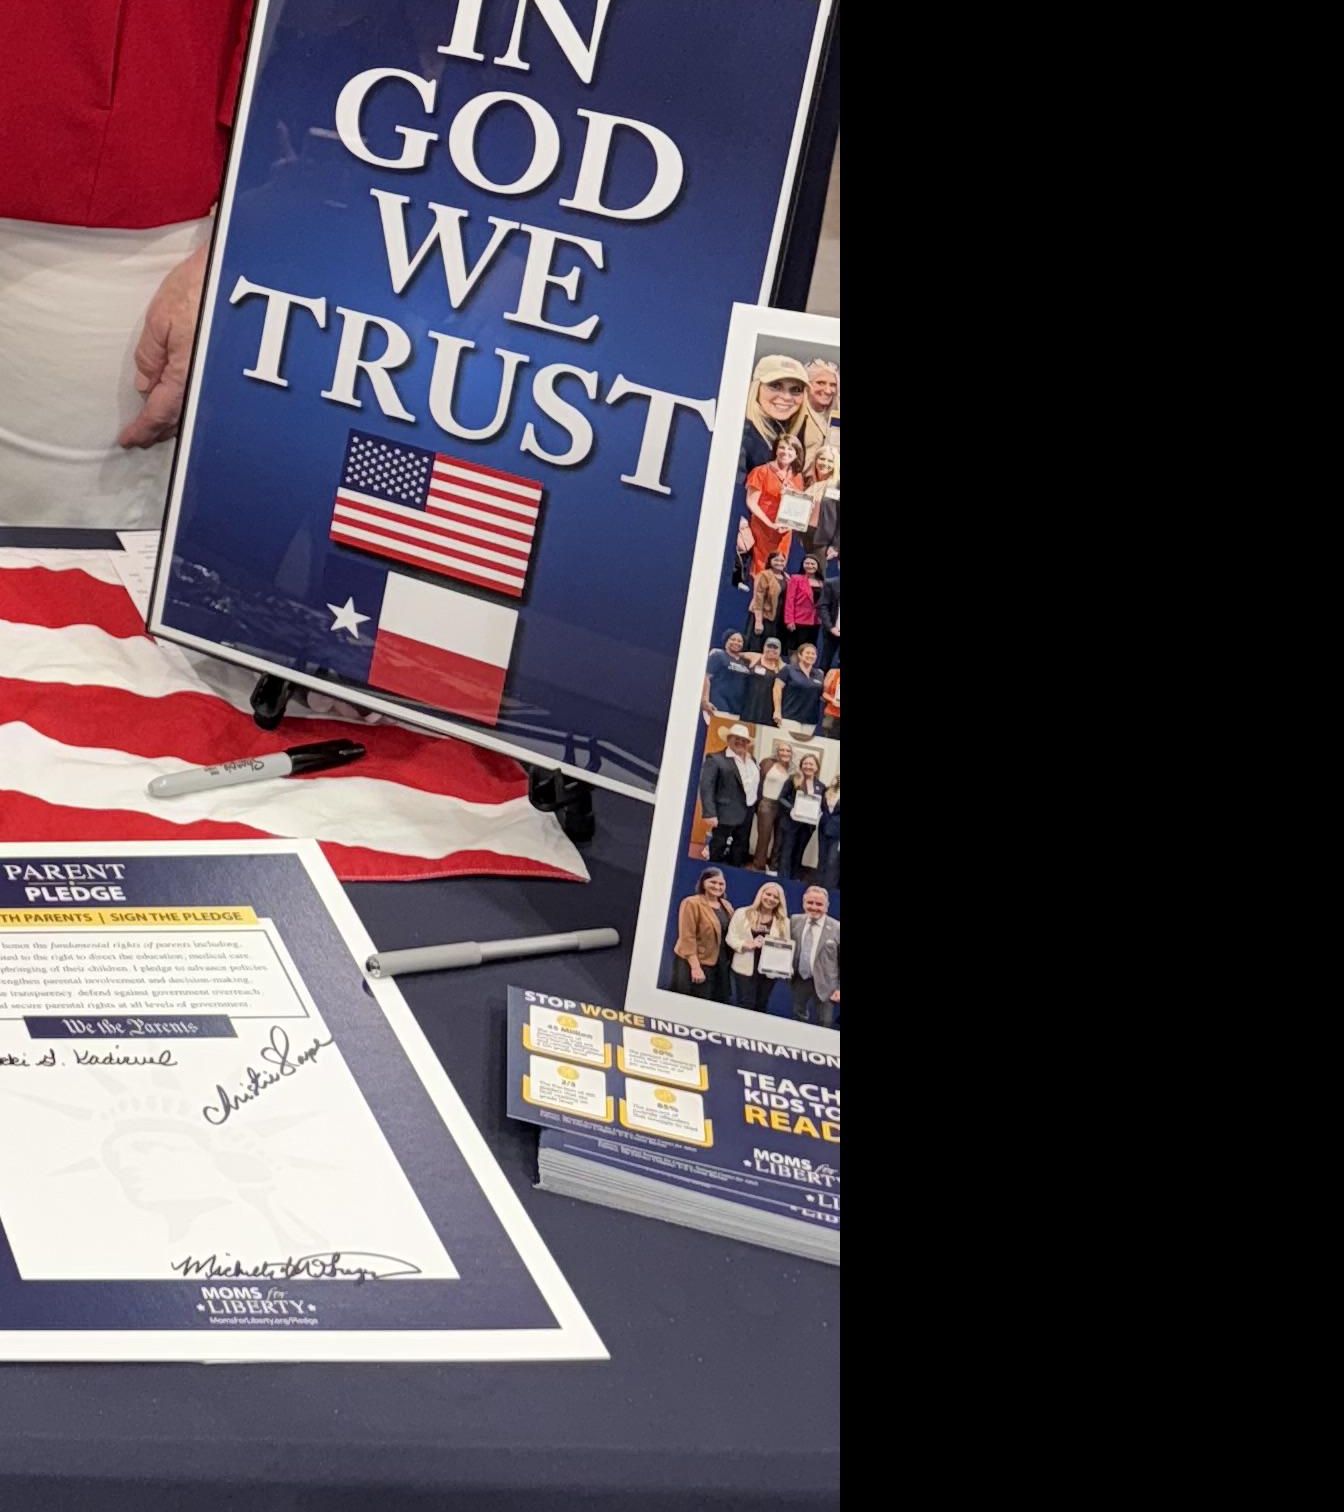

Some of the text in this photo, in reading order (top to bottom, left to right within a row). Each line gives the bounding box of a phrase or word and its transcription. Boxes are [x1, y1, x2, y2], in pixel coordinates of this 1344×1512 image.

[335, 67, 684, 220] GOD
[370, 188, 605, 340] WE
[229, 276, 716, 495] TRUST
[3, 863, 126, 881] PARENT
[25, 886, 126, 902] PLEDGE
[24, 912, 92, 924] PARENTS
[111, 912, 150, 923] SIGN
[151, 912, 181, 922] THE
[182, 911, 244, 922] PLEDGE
[63, 1018, 199, 1037] We the Parents
[524, 990, 576, 1010] STOP
[580, 1002, 645, 1028] WOKE
[650, 1018, 840, 1069] INDOCTRINATION
[737, 1069, 840, 1107] TEACH
[744, 1088, 805, 1113] KIDS
[753, 1148, 812, 1171] MOMS
[201, 1286, 289, 1301] MOMS for
[208, 1299, 305, 1314] LIBERTY
